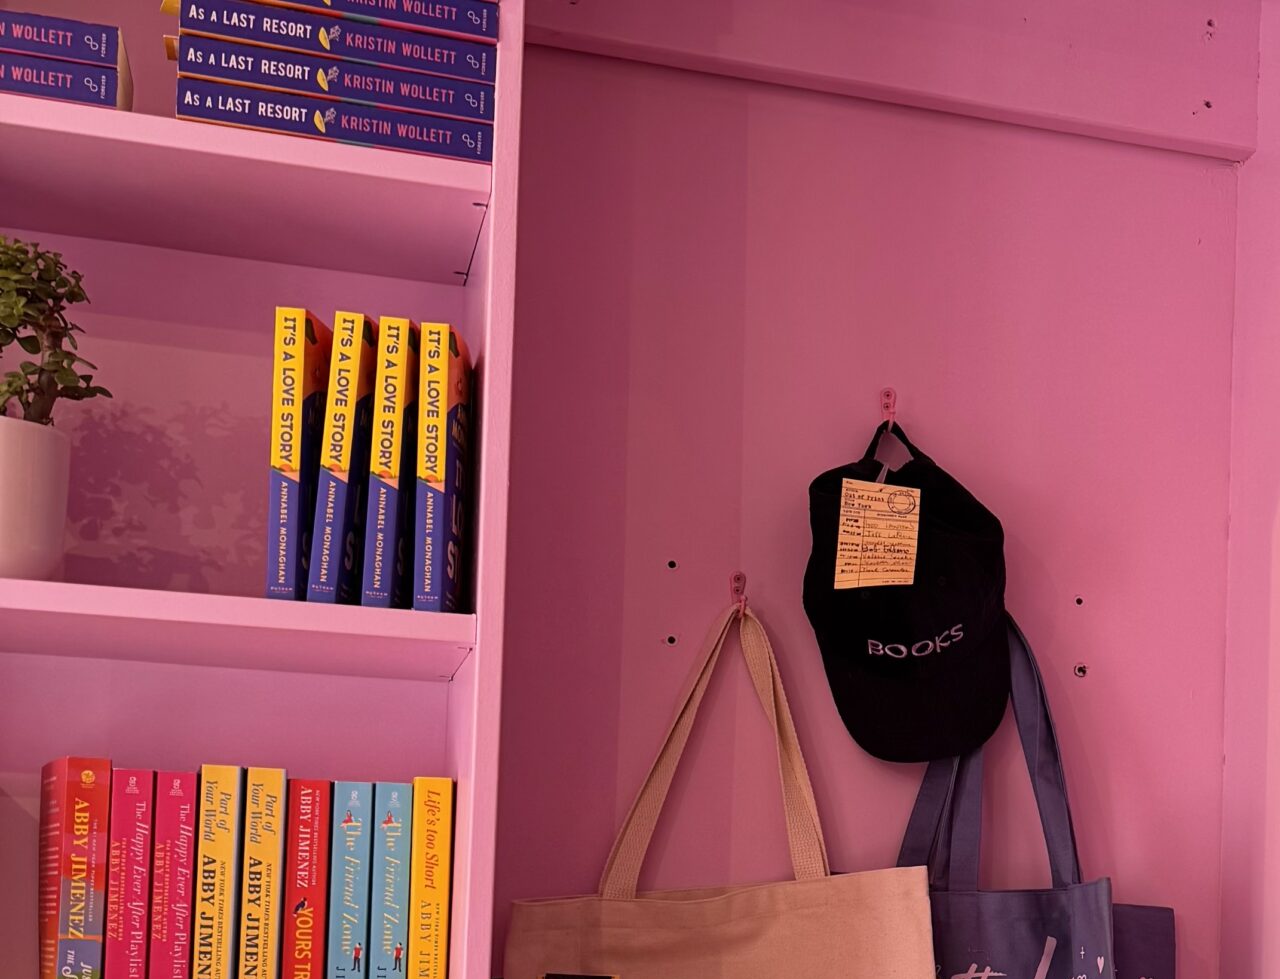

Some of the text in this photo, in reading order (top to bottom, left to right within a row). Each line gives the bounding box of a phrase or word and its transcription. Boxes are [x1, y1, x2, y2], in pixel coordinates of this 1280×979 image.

[208, 53, 216, 64] A
[222, 52, 253, 71] LAST
[261, 58, 310, 80] RESORT
[344, 73, 455, 104] KRISTIN WOLLETT
[280, 316, 296, 463] IT'S A LOVE STORY
[278, 481, 288, 584] ANNABEL MONAGHAN
[868, 624, 964, 658] BOOKS
[202, 780, 218, 842] Your World
[216, 791, 232, 832] Part of
[296, 786, 313, 888] ABBY JIMENEZ
[424, 790, 441, 890] Life's too Short
[68, 798, 90, 939] ABBY JIMENEZ
[201, 854, 216, 907] ABBY
[295, 907, 314, 961] YOURS
